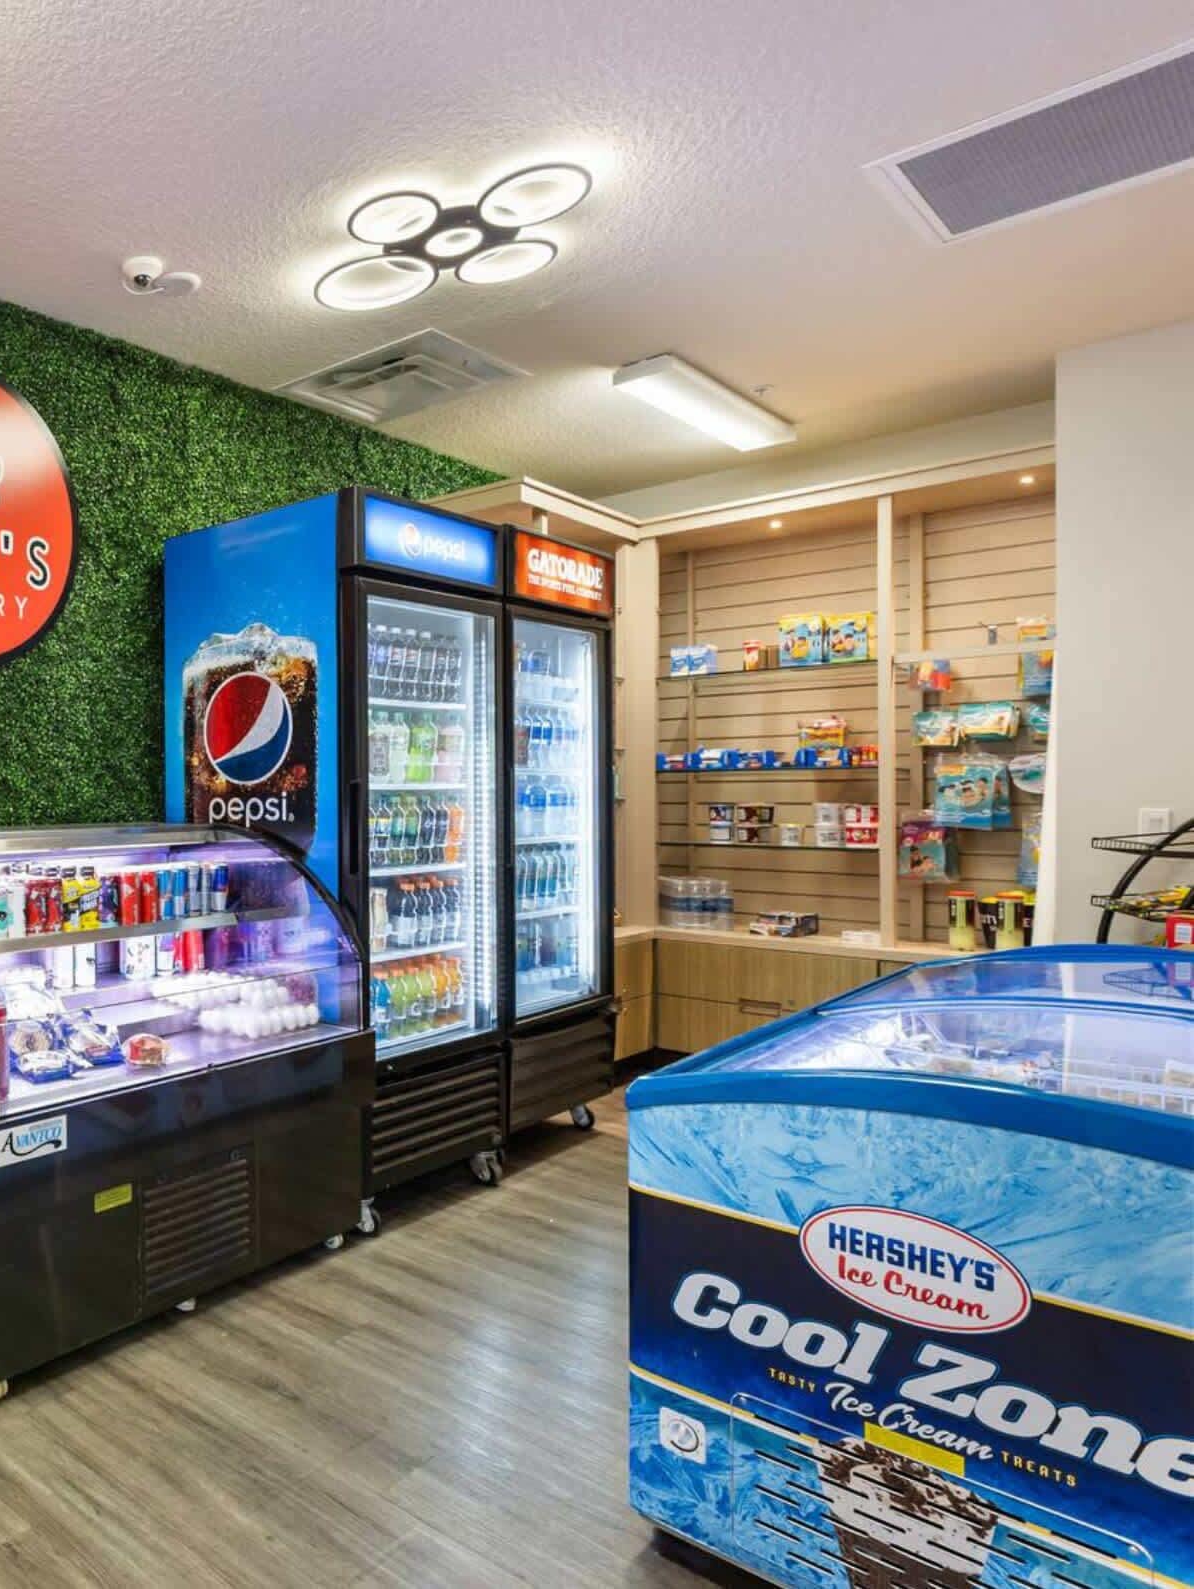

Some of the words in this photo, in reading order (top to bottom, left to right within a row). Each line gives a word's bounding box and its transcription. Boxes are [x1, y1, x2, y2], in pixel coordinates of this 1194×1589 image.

[422, 536, 466, 561] pepsi
[527, 548, 604, 590] GATORADE
[208, 791, 287, 828] pepsi
[1, 1127, 62, 1156] AVANTCO
[828, 1222, 995, 1292] HERSHEY'S
[837, 1253, 878, 1287] Ice
[883, 1269, 990, 1321] Cream
[673, 1272, 889, 1385] Cool
[898, 1343, 1194, 1497] Zone
[769, 1367, 816, 1393] TASTY
[824, 1382, 876, 1417] Ice
[877, 1403, 994, 1460] Cream
[1001, 1450, 1078, 1488] TREATS
